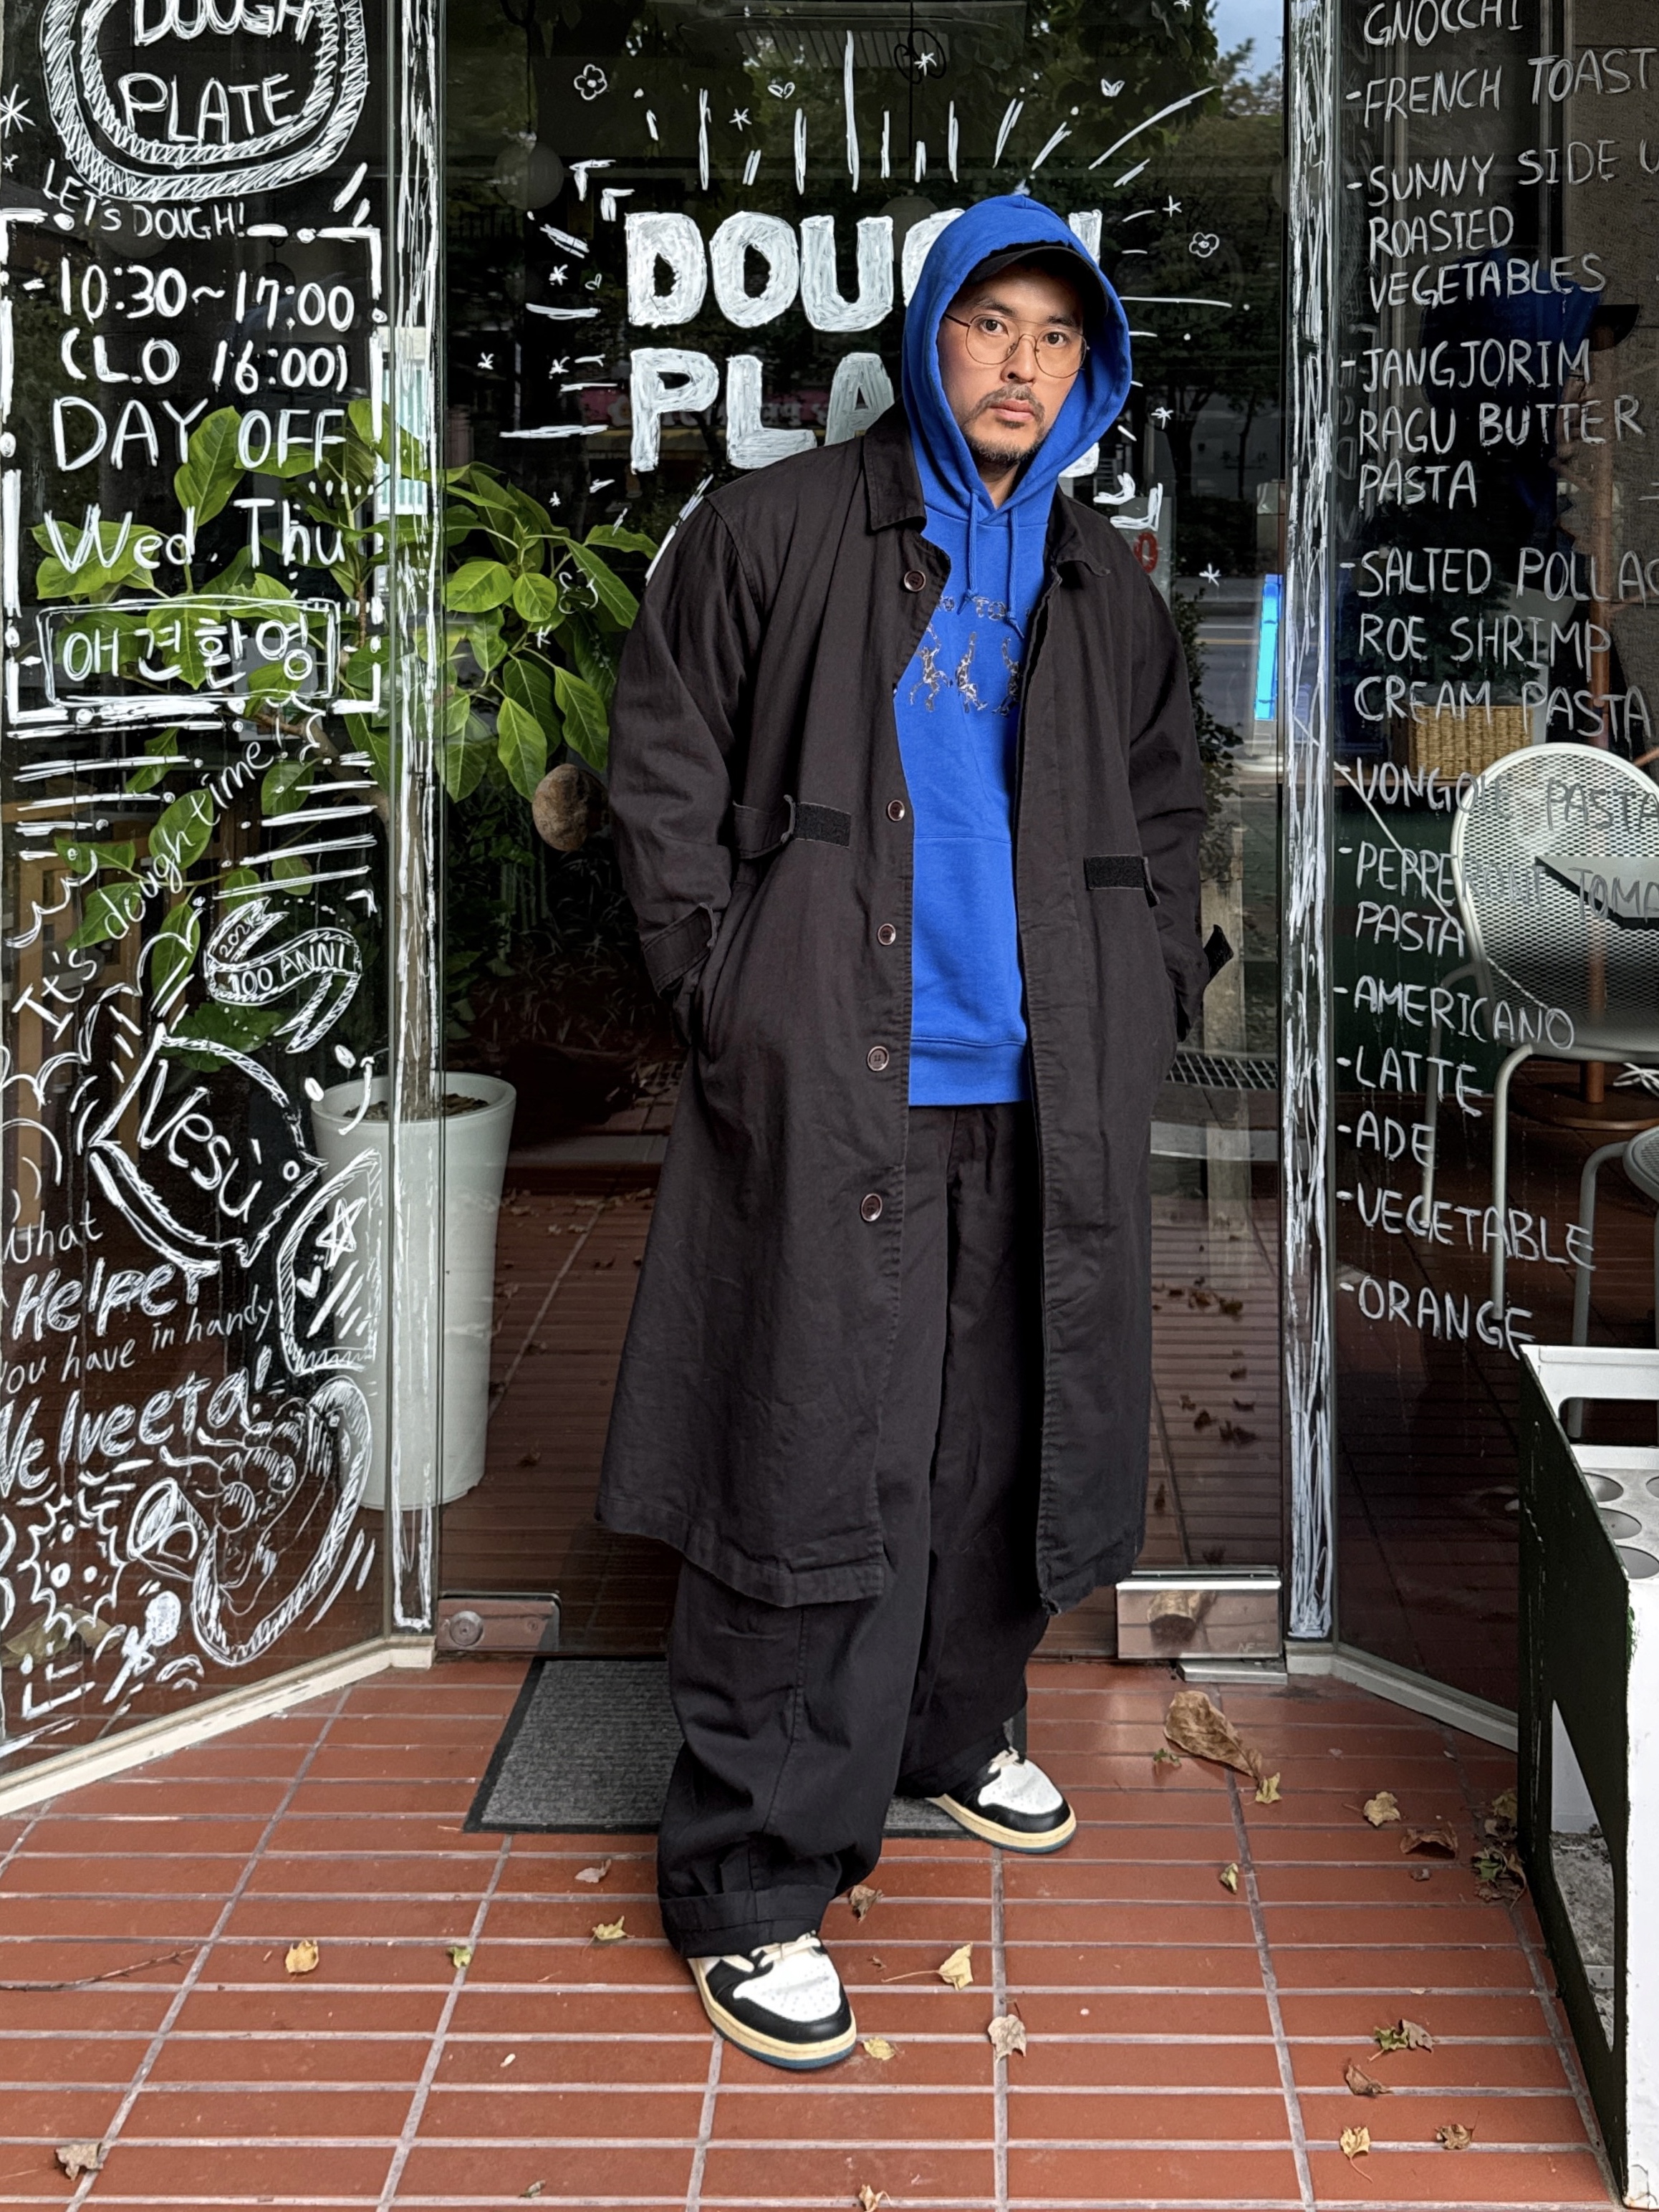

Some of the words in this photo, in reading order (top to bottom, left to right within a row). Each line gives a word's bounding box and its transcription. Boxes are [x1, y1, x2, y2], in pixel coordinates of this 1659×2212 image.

[1363, 0, 1522, 47] GNOCCHI
[118, 72, 294, 144] PLATE
[1527, 48, 1659, 104] TOAST
[1518, 140, 1620, 185] SIDE
[42, 158, 122, 231] LET'S
[133, 202, 245, 240] DOUGH!
[1369, 206, 1515, 266] ROASTED
[625, 208, 1103, 332] DOU
[1369, 252, 1607, 313] VEGETABLES
[212, 337, 347, 395] 16:00)
[53, 395, 208, 472] DAY
[238, 408, 347, 470] OFF
[1360, 405, 1456, 456] RAGU
[1478, 393, 1646, 448] BUTTER
[1359, 458, 1478, 511] PASTA
[233, 497, 347, 569] Thu
[62, 610, 314, 689] 애견환영
[1359, 612, 1428, 662] ROE
[1449, 614, 1612, 683] SHRIMP
[1354, 675, 1492, 727] CREAM
[1521, 680, 1651, 751] PASTA
[1547, 776, 1659, 834] PASTA
[11, 949, 97, 1042] It's
[105, 826, 196, 940] dough
[1355, 901, 1465, 958] PASTA
[228, 967, 274, 996] 100
[280, 942, 345, 983] ANNI
[12, 1257, 220, 1341] Helper
[62, 1336, 136, 1381] have
[152, 1323, 174, 1352] in
[186, 1284, 273, 1342] handy
